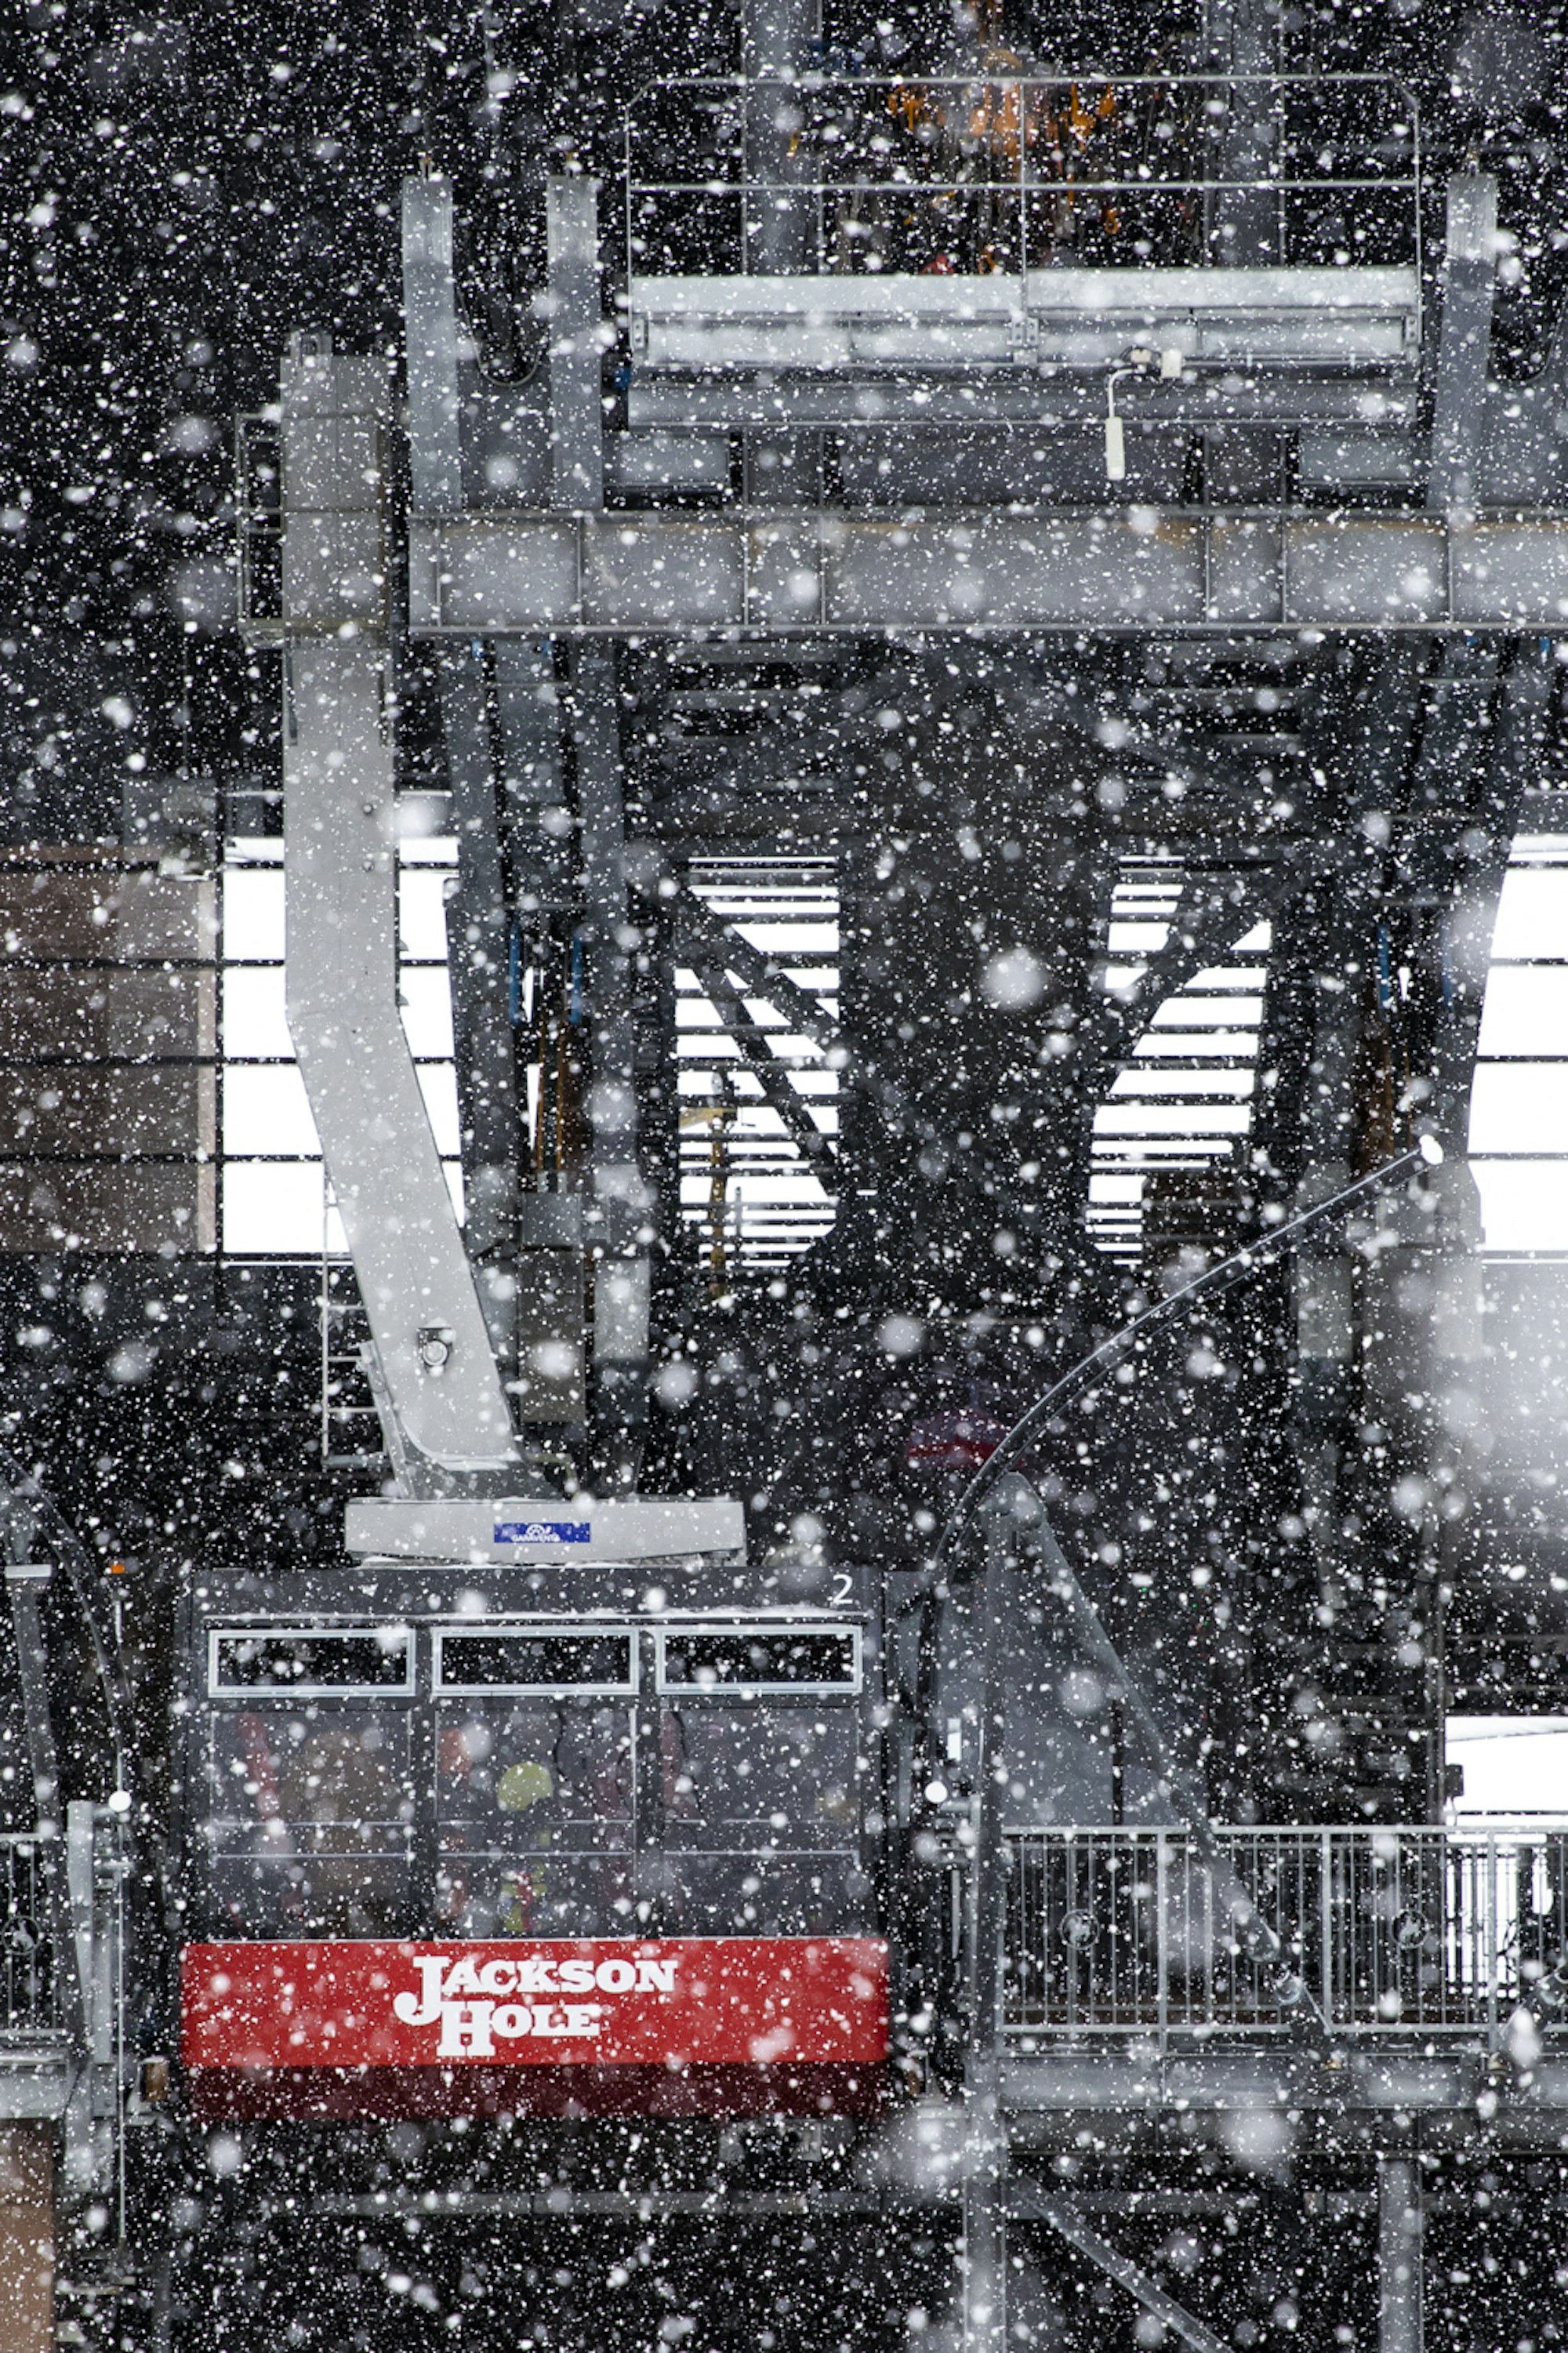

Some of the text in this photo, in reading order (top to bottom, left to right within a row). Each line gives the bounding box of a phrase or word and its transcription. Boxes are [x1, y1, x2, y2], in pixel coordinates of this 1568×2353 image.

[833, 1574, 853, 1604] 2
[394, 1955, 678, 2025] JACKSON
[436, 2001, 601, 2056] HOLE
